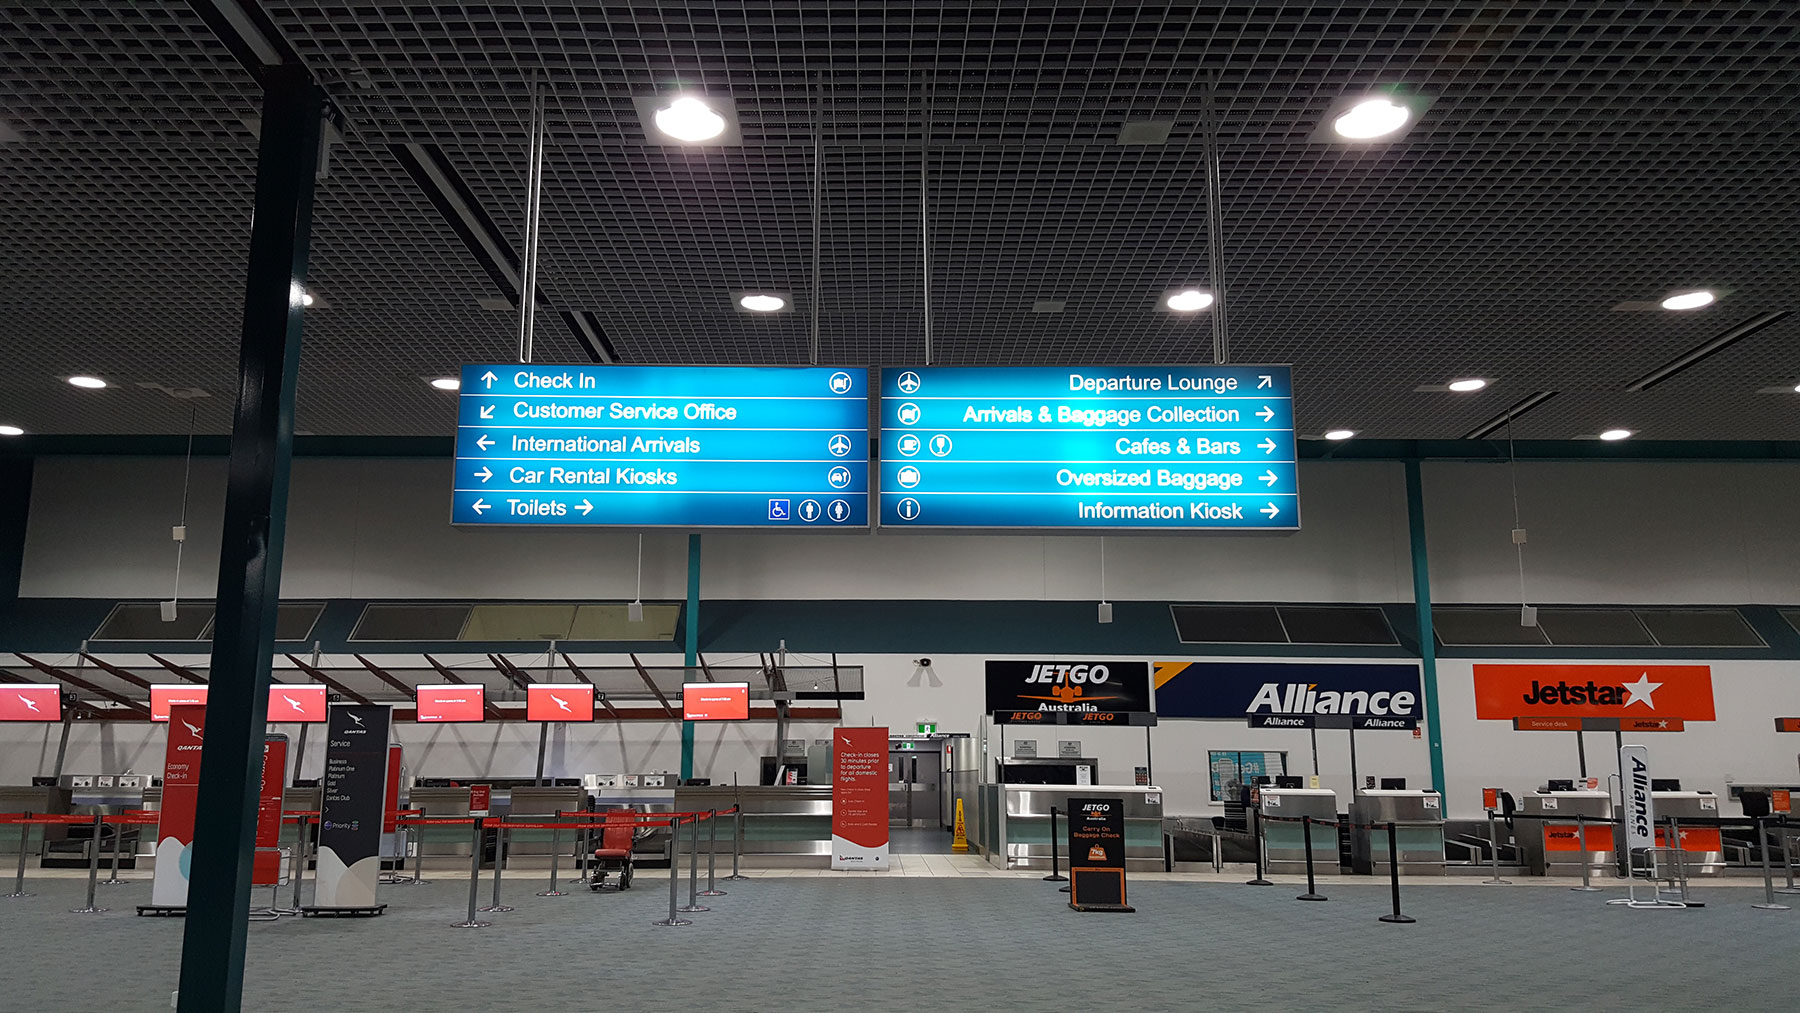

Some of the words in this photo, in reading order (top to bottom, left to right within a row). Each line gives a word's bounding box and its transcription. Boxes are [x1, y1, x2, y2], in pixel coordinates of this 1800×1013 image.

[514, 371, 573, 388] Check
[579, 371, 596, 388] In
[1069, 374, 1161, 394] Departure
[1168, 376, 1238, 394] Lounge
[513, 402, 604, 420] Customer
[609, 403, 678, 420] Service
[683, 403, 737, 420] Office
[962, 405, 1032, 423] Arrivals
[1037, 406, 1052, 424] &
[1057, 406, 1141, 427] Baggage
[1146, 407, 1240, 425] Collection
[512, 434, 626, 453] International
[630, 436, 701, 454] Arrivals
[1115, 438, 1171, 455] Cafes
[1176, 438, 1191, 455] &
[1196, 438, 1241, 455] Bars
[509, 467, 545, 484] Car
[549, 467, 610, 484] Rental
[616, 467, 678, 485] Kiosks
[1056, 469, 1150, 487] Oversized
[1157, 470, 1243, 491] Baggage
[506, 499, 567, 516] Toilets
[1078, 502, 1183, 519] Information
[1190, 502, 1244, 520] Kiosk
[1025, 664, 1110, 684] JETGO
[1245, 683, 1416, 716] Alliance
[1523, 680, 1627, 706] Jetstar
[1038, 702, 1098, 712] Australia
[1010, 712, 1042, 720] JETGO
[1082, 713, 1114, 721] JETGO
[1263, 717, 1305, 726] Alliance
[1364, 719, 1406, 728] Alliance
[1531, 720, 1553, 728] Service
[1633, 721, 1659, 729] Jetstar
[330, 740, 351, 748] Service
[167, 763, 189, 771] Economy
[1631, 756, 1649, 838] Alliance
